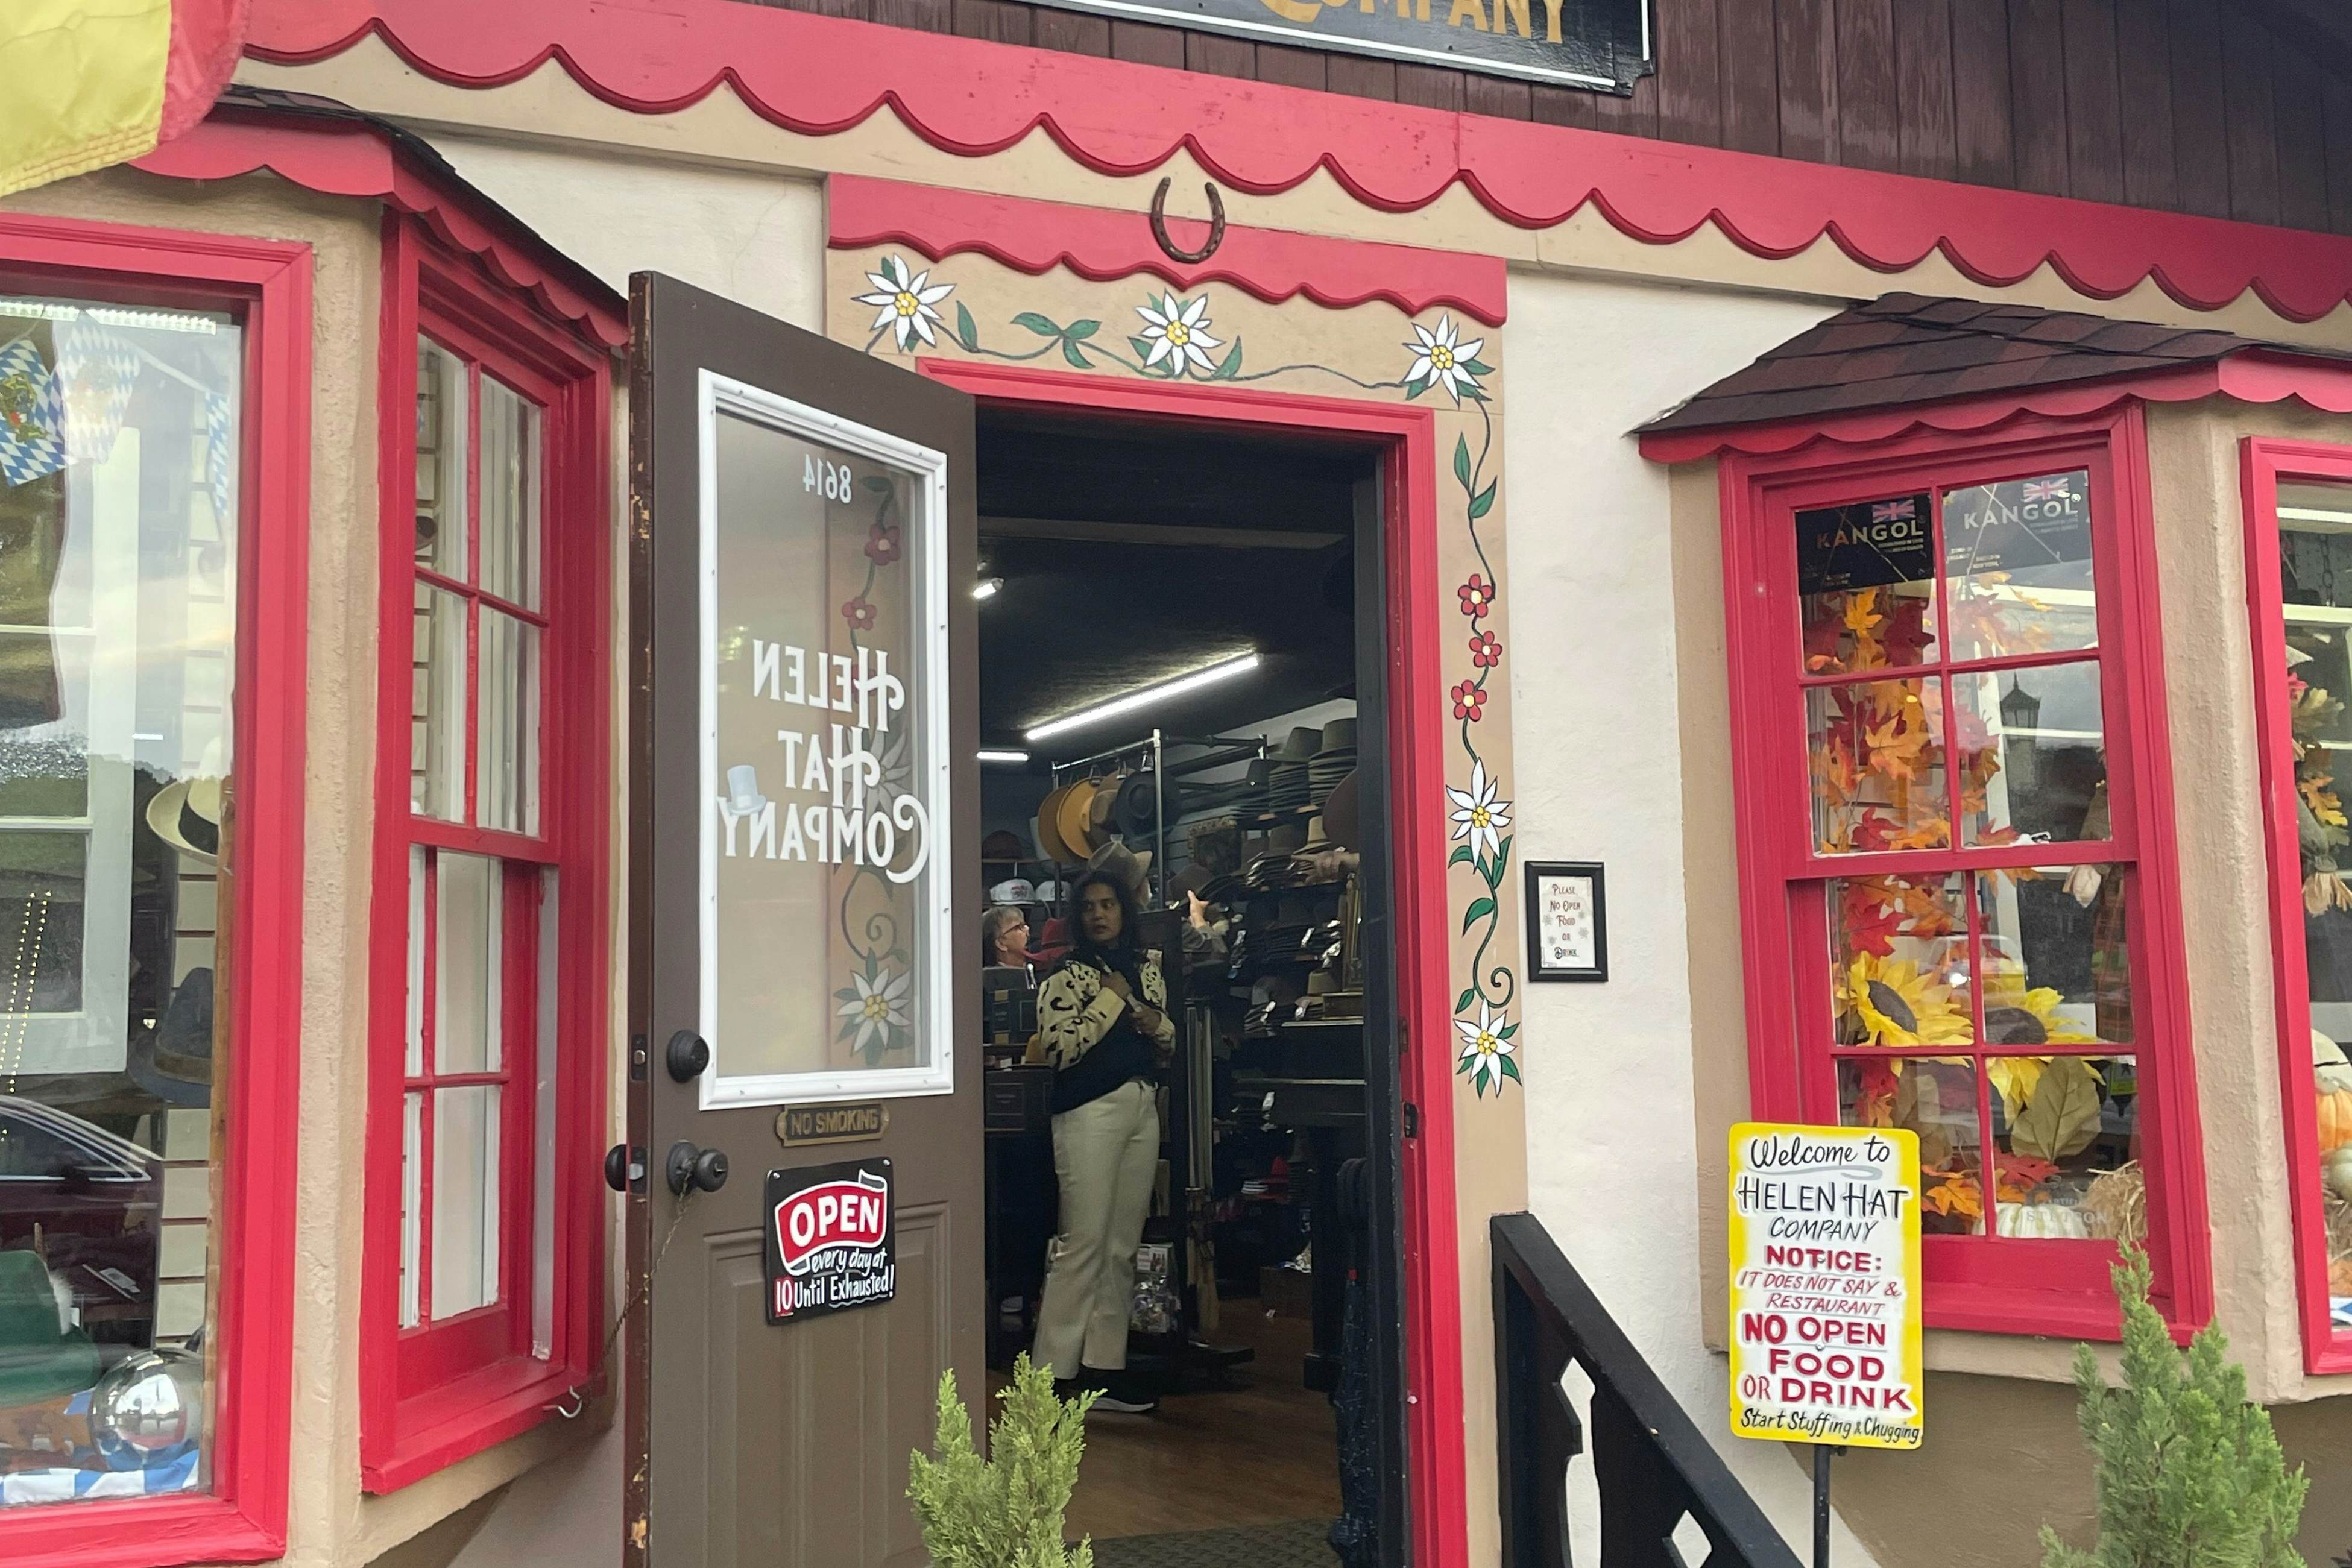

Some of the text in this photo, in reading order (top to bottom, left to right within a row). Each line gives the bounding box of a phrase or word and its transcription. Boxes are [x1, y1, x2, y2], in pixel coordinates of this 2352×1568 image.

[1964, 499, 2078, 529] KANGOL
[1816, 520, 1924, 549] KANGOL
[1556, 915, 1575, 927] FOOD
[1563, 900, 1580, 912] OPEN
[792, 1109, 878, 1136] NO SMOKING
[1750, 1135, 1890, 1168] Welcome to
[1738, 1176, 1909, 1218] HELEN HAT
[789, 1195, 880, 1247] OPEN
[1770, 1216, 1879, 1241] COMPANY
[812, 1247, 887, 1277] every day at
[1766, 1245, 1881, 1272] NOTICE:
[777, 1264, 895, 1312] 10 Until Exhausted!
[1740, 1271, 1902, 1297] IT DOES NOT SAY &
[1767, 1293, 1885, 1315] RESTAURANT
[1744, 1314, 1885, 1346] NO OPEN
[1769, 1349, 1884, 1381] FOOD
[1744, 1375, 1911, 1411] OR DRINK
[1741, 1408, 1920, 1444] Start Stuffing & Chugging
